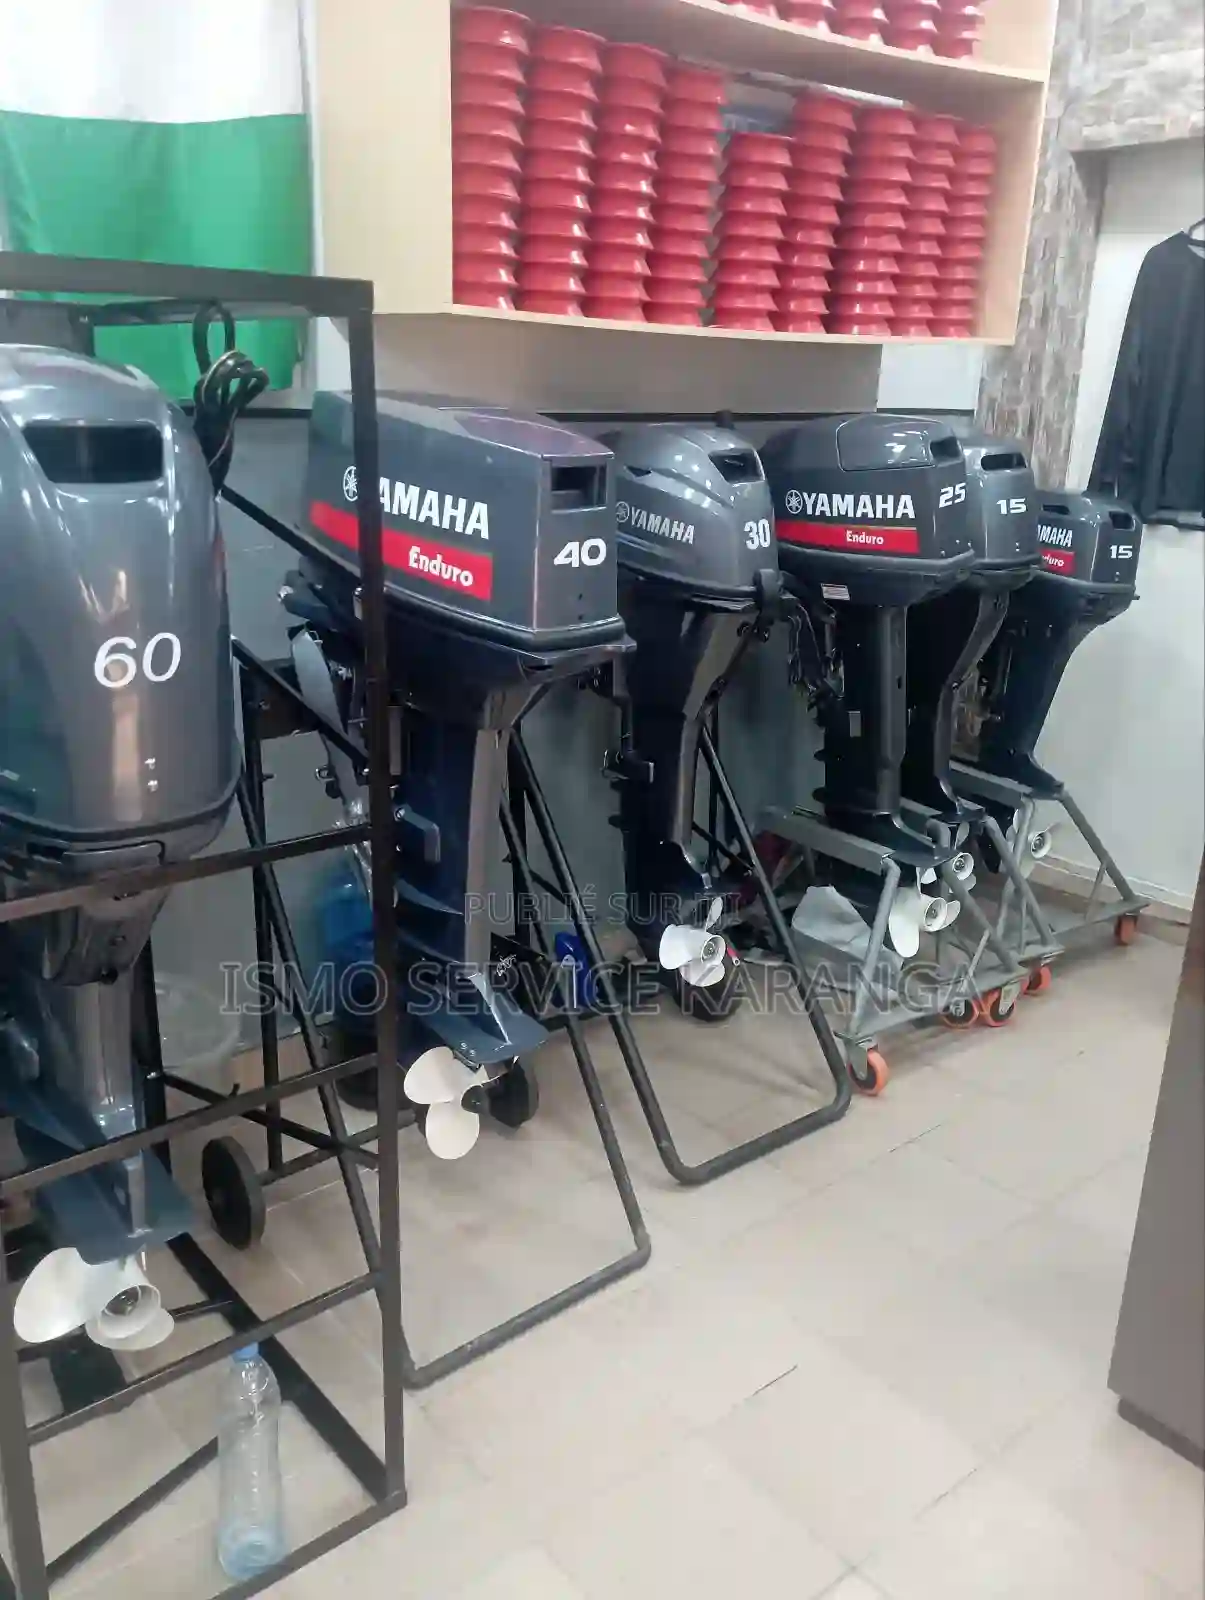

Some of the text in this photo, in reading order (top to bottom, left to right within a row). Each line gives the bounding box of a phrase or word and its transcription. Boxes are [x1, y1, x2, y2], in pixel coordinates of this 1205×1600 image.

[379, 476, 490, 540] AMAHA
[802, 492, 916, 519] YAMAHA
[938, 482, 967, 509] 25
[996, 497, 1028, 515] 15
[630, 506, 695, 545] YAMAHA
[743, 518, 771, 550] 30
[845, 530, 884, 545] Enduro
[1037, 524, 1073, 547] MAHA
[408, 545, 474, 587] Enduro
[553, 538, 607, 568] 40
[1109, 545, 1133, 559] 15
[94, 632, 182, 688] 60
